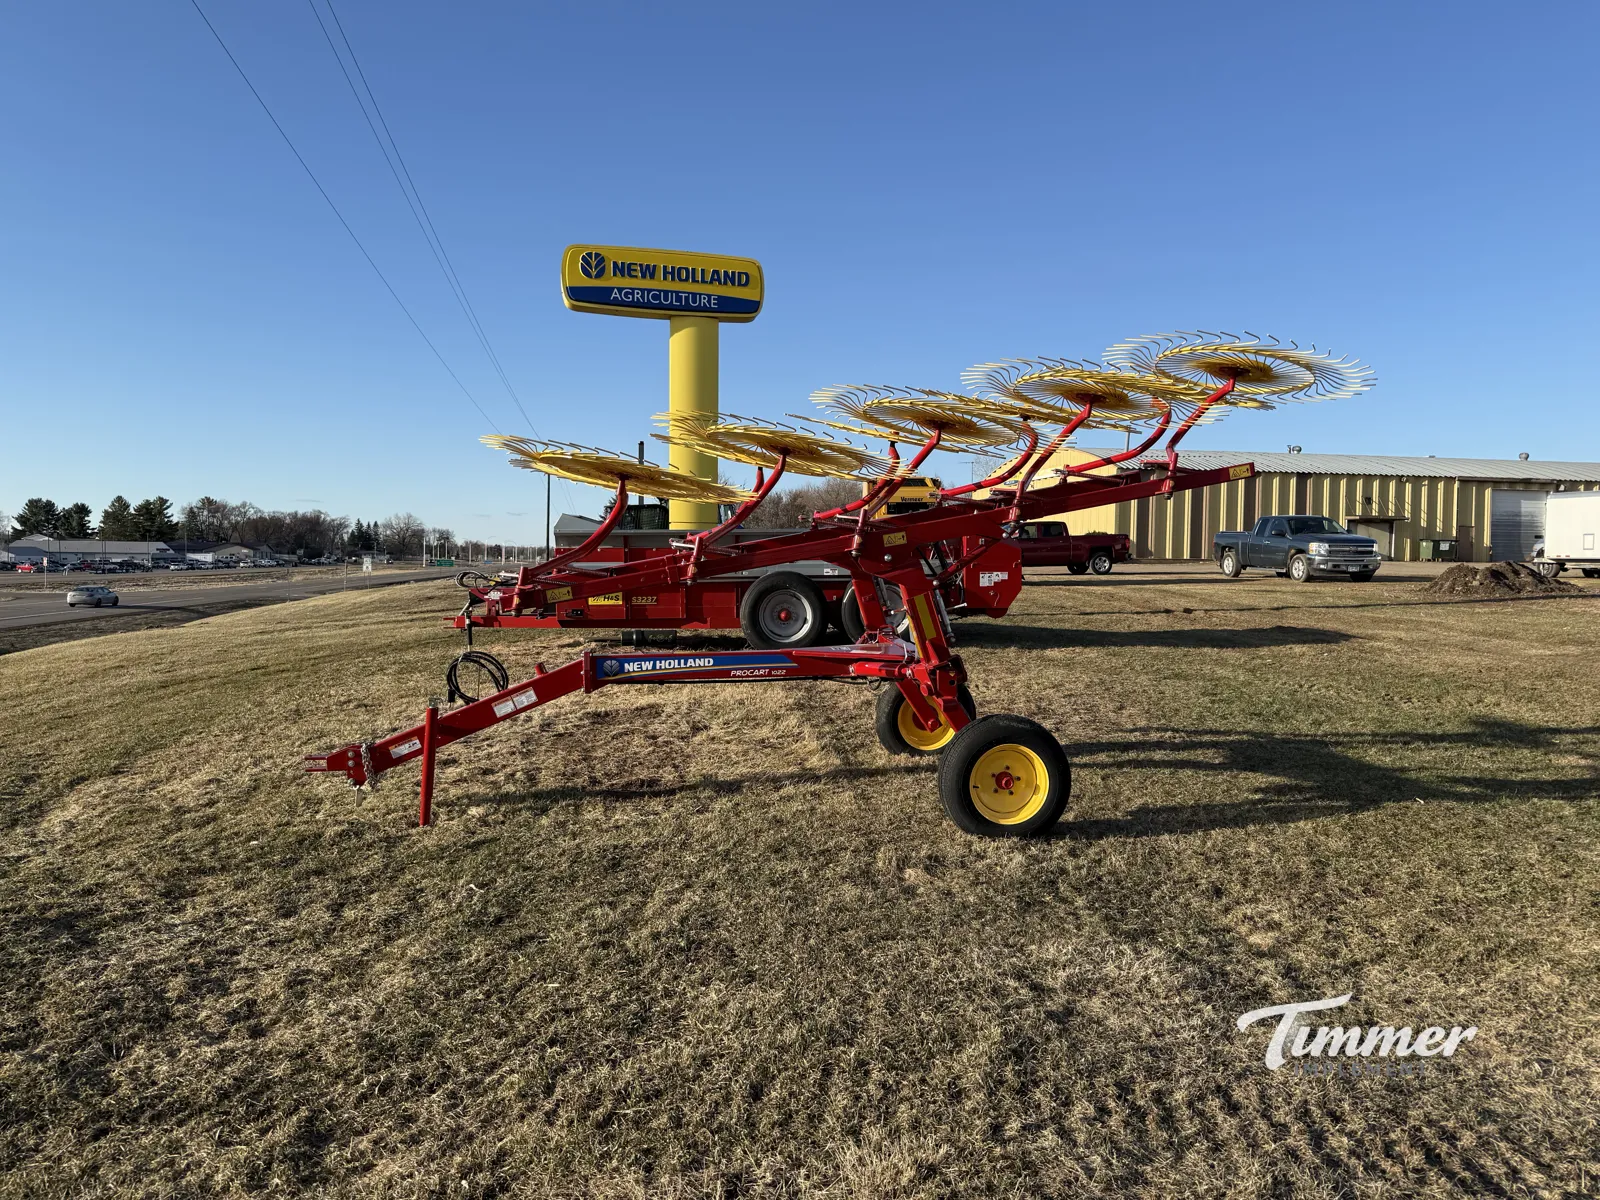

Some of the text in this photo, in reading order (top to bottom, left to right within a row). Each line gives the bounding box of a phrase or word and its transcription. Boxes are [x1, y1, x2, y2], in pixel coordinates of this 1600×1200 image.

[612, 260, 750, 287] NEW HOLLAND
[610, 288, 719, 308] AGRICULTURE
[624, 658, 714, 673] NEW HOLLAND
[730, 668, 769, 677] PROCART
